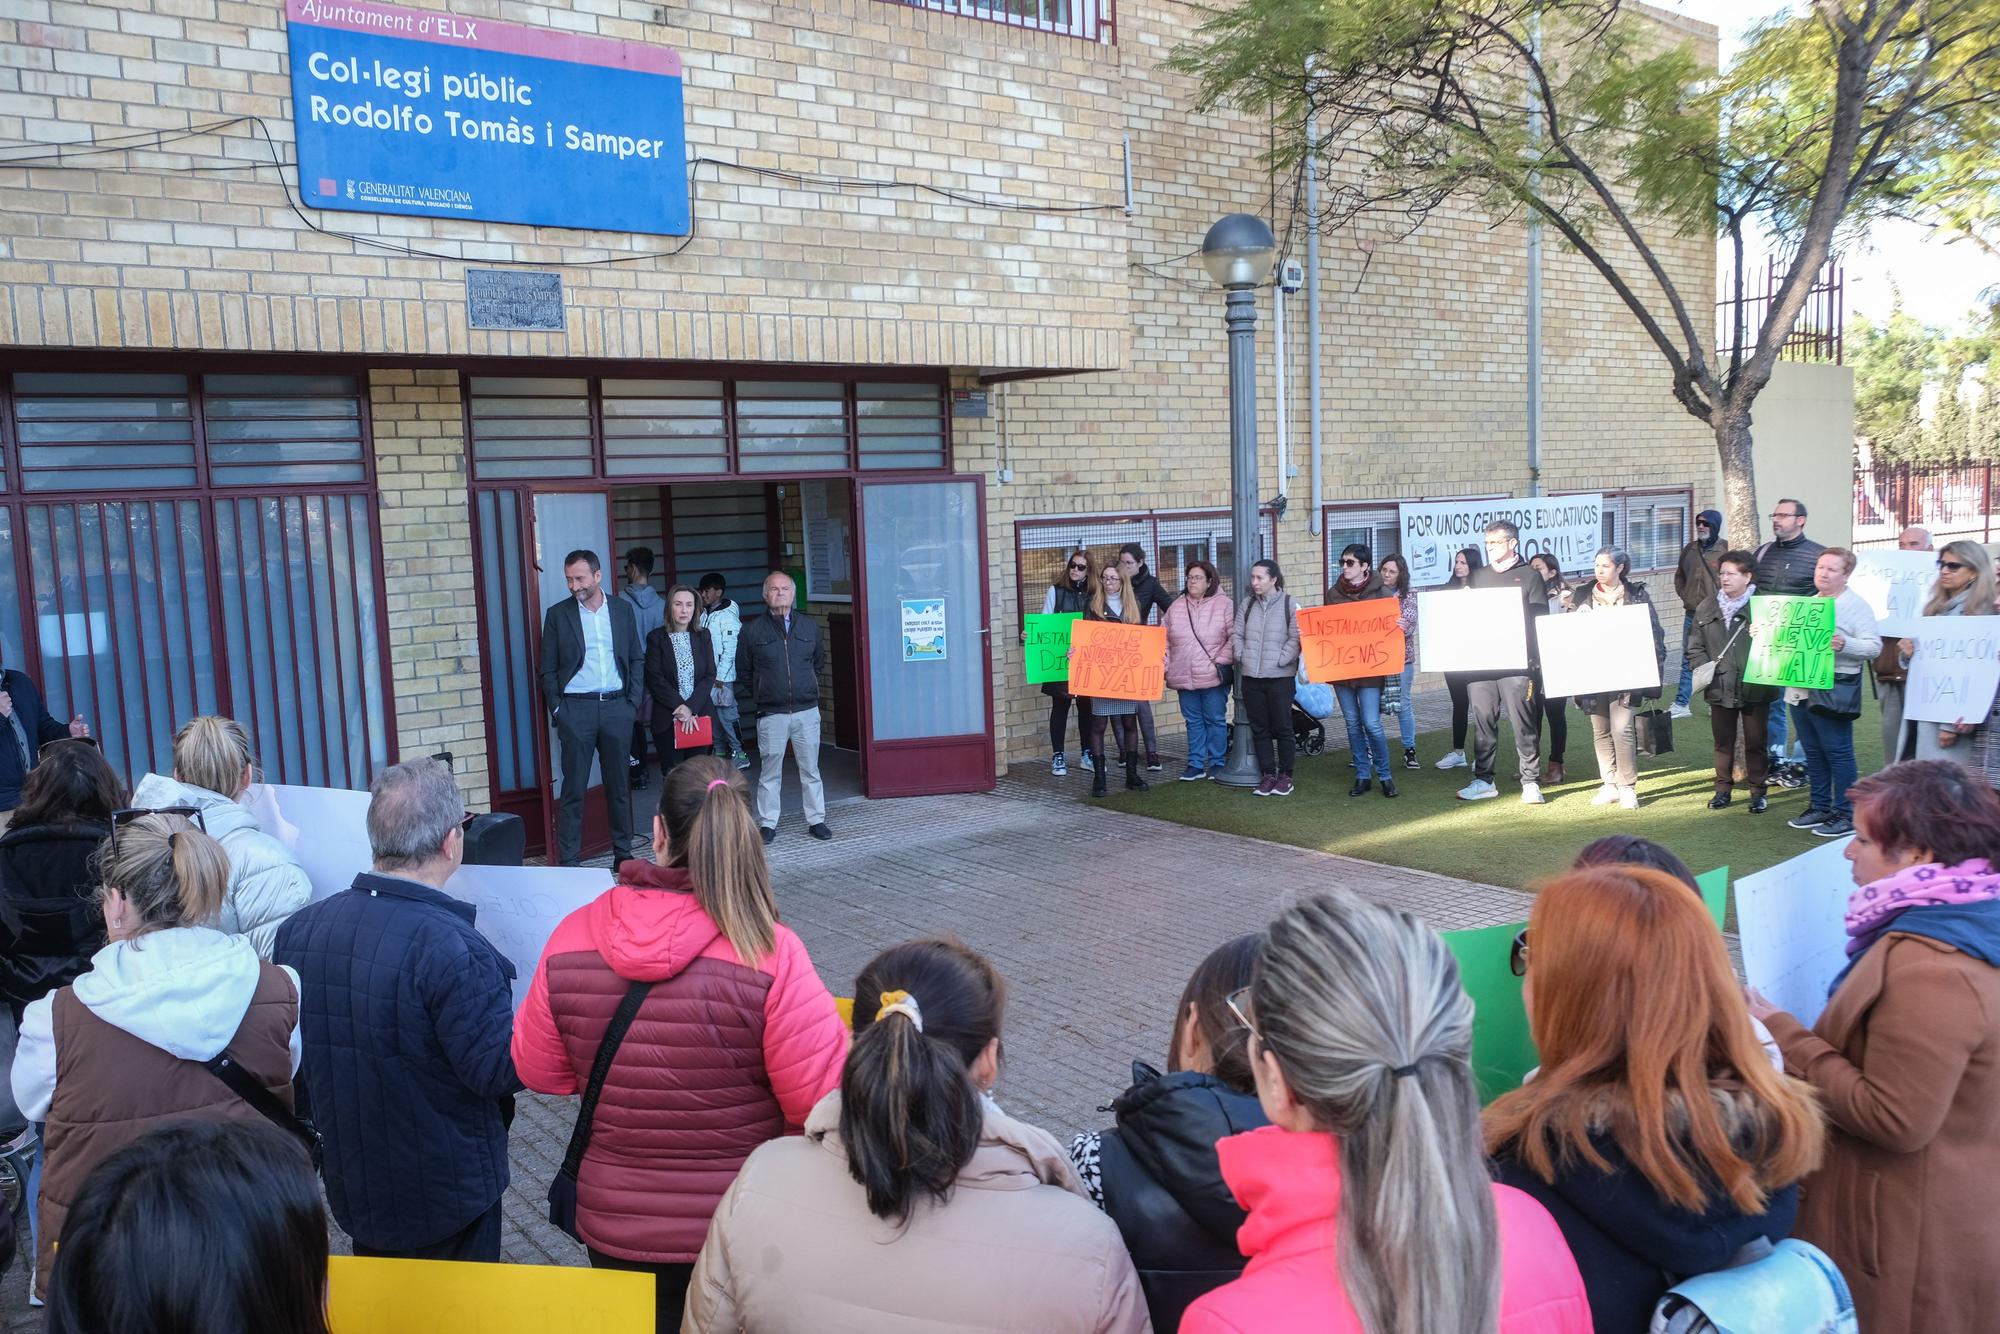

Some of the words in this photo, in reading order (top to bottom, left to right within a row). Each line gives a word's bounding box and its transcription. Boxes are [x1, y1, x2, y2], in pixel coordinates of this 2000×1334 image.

[301, 0, 413, 32] Ajuntament
[419, 15, 478, 41] d'ELX
[443, 72, 532, 105] públic
[310, 94, 433, 135] Rodolfo
[444, 110, 536, 146] Tomàs
[546, 120, 553, 147] i
[564, 124, 664, 160] Samper
[358, 181, 415, 198] GENERALITAT
[418, 186, 472, 203] VALENCIANA
[1407, 515, 1434, 537] POR
[1436, 513, 1470, 536] UNOS
[1536, 505, 1598, 529] EDUCATIVOS
[1300, 610, 1399, 637] INSTALACIONES
[1767, 600, 1825, 627] COLE
[1090, 626, 1142, 650] COLE
[1079, 645, 1143, 667] NUEVO
[1316, 640, 1390, 669] DIGNAS
